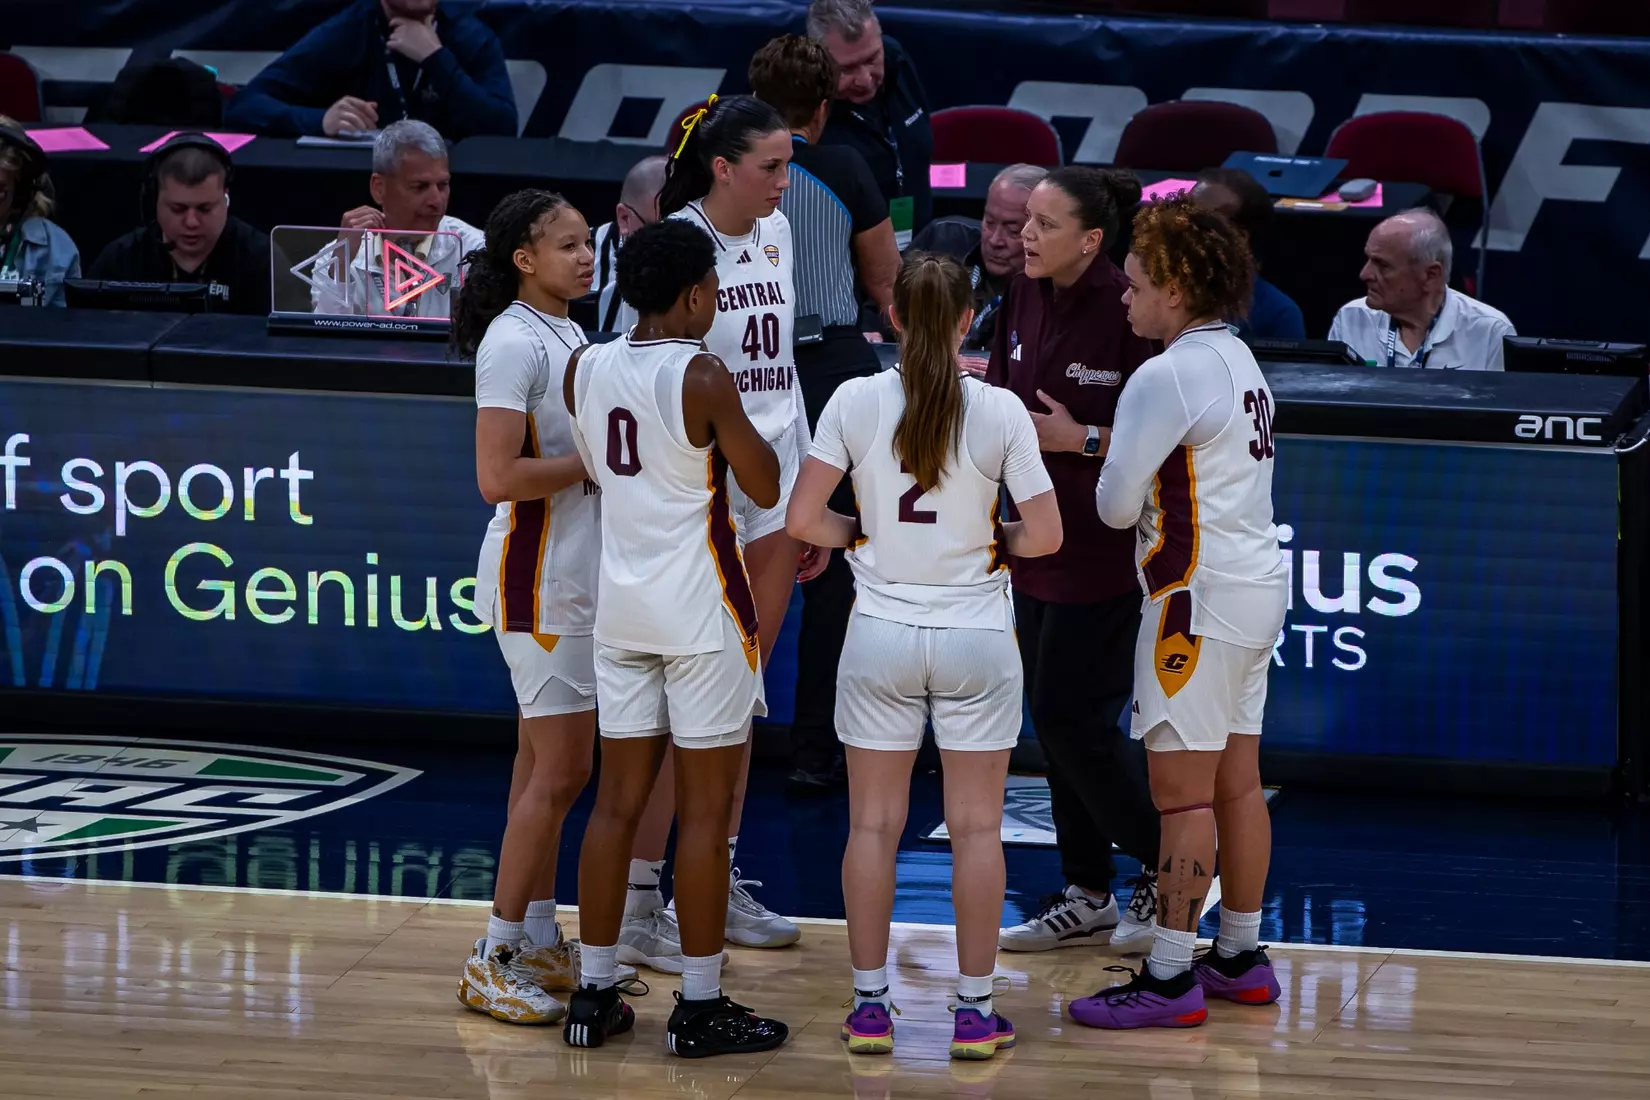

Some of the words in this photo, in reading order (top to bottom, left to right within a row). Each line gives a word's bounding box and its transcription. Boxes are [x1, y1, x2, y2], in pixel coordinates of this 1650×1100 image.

[717, 281, 786, 312] CENTRAL
[741, 313, 780, 361] 40
[606, 406, 643, 477] 0
[1243, 388, 1274, 462] 30
[1515, 415, 1602, 440] anc
[0, 433, 31, 510] f
[60, 451, 314, 536] sport
[898, 459, 938, 524] 2
[20, 556, 133, 615] on
[165, 542, 494, 634] Genius
[1276, 523, 1422, 617] ius
[32, 753, 189, 769] 1946
